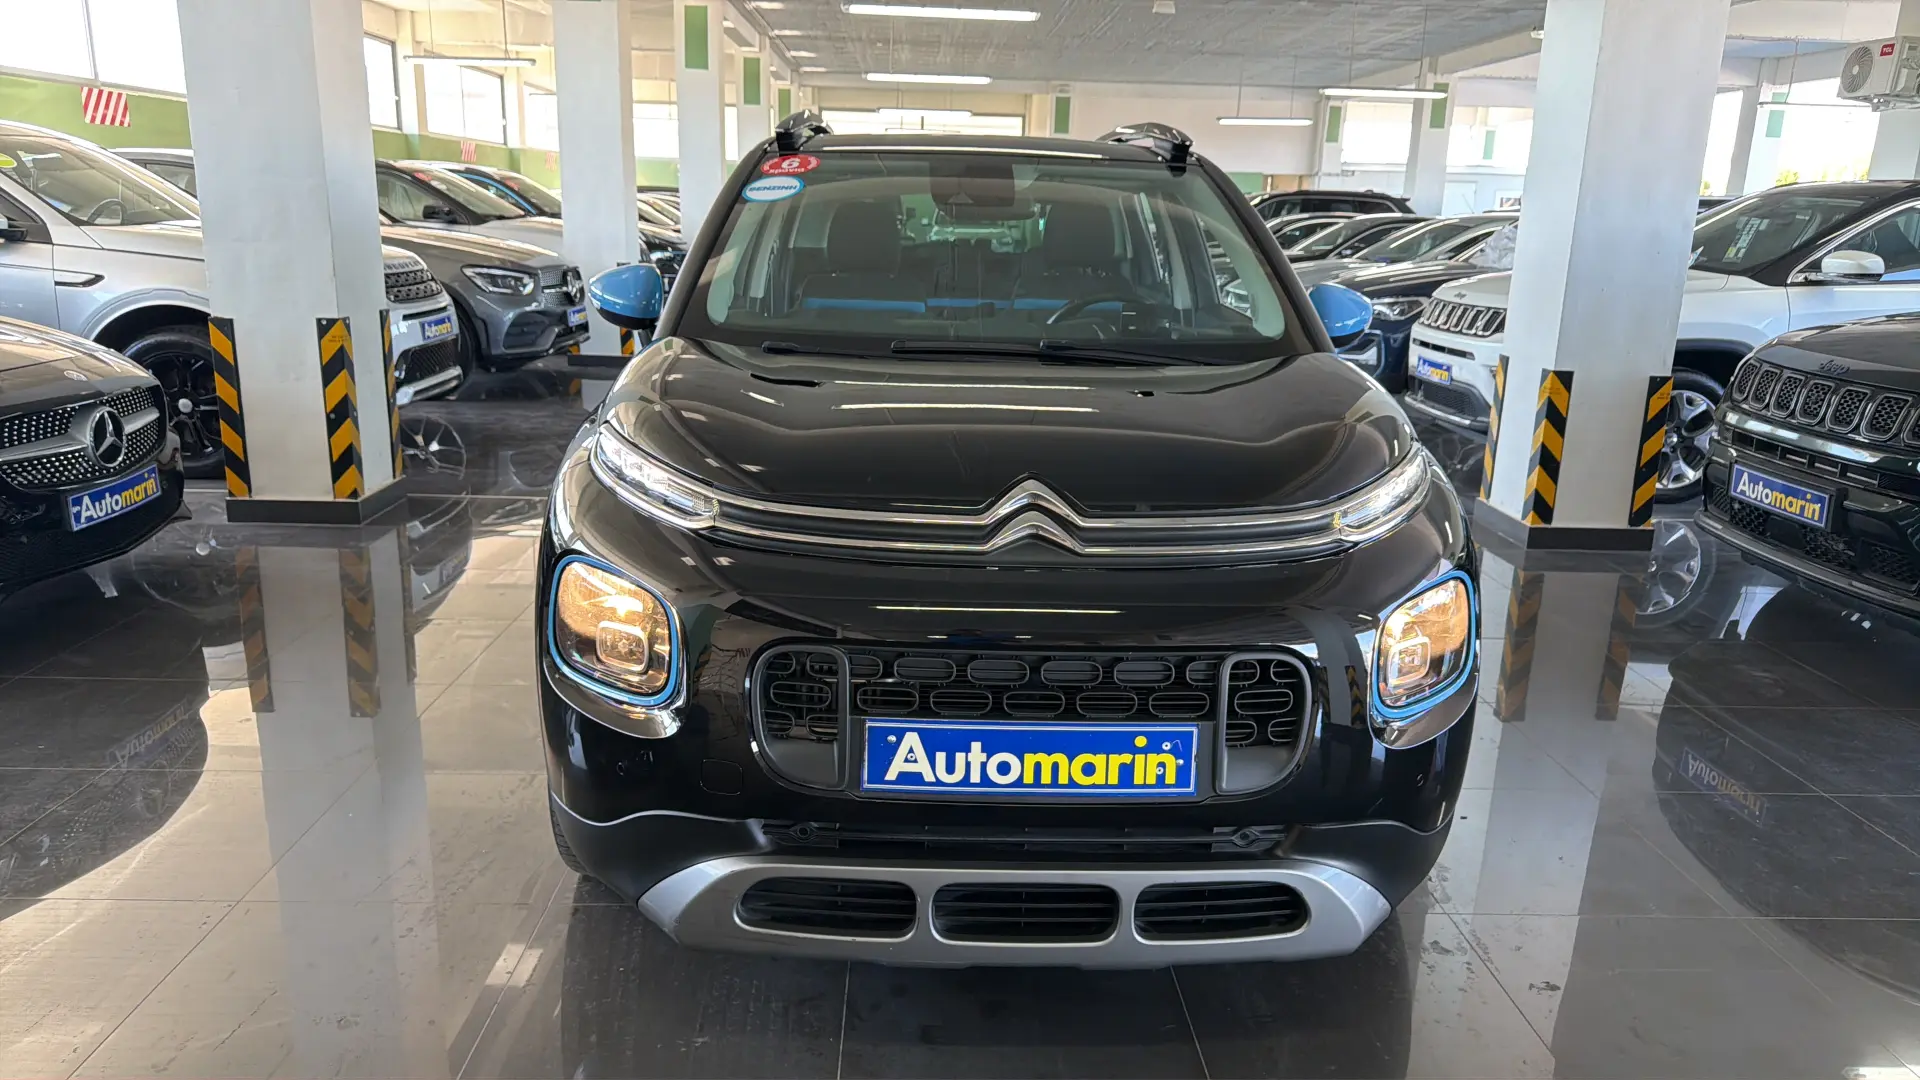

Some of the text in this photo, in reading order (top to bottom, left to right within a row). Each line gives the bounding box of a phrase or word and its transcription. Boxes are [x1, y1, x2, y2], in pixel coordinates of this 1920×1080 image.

[781, 158, 801, 169] 6
[1820, 360, 1850, 376] Jeep
[81, 472, 156, 524] Automarin
[1736, 472, 1820, 521] Automarin
[884, 732, 1176, 785] Automarin
